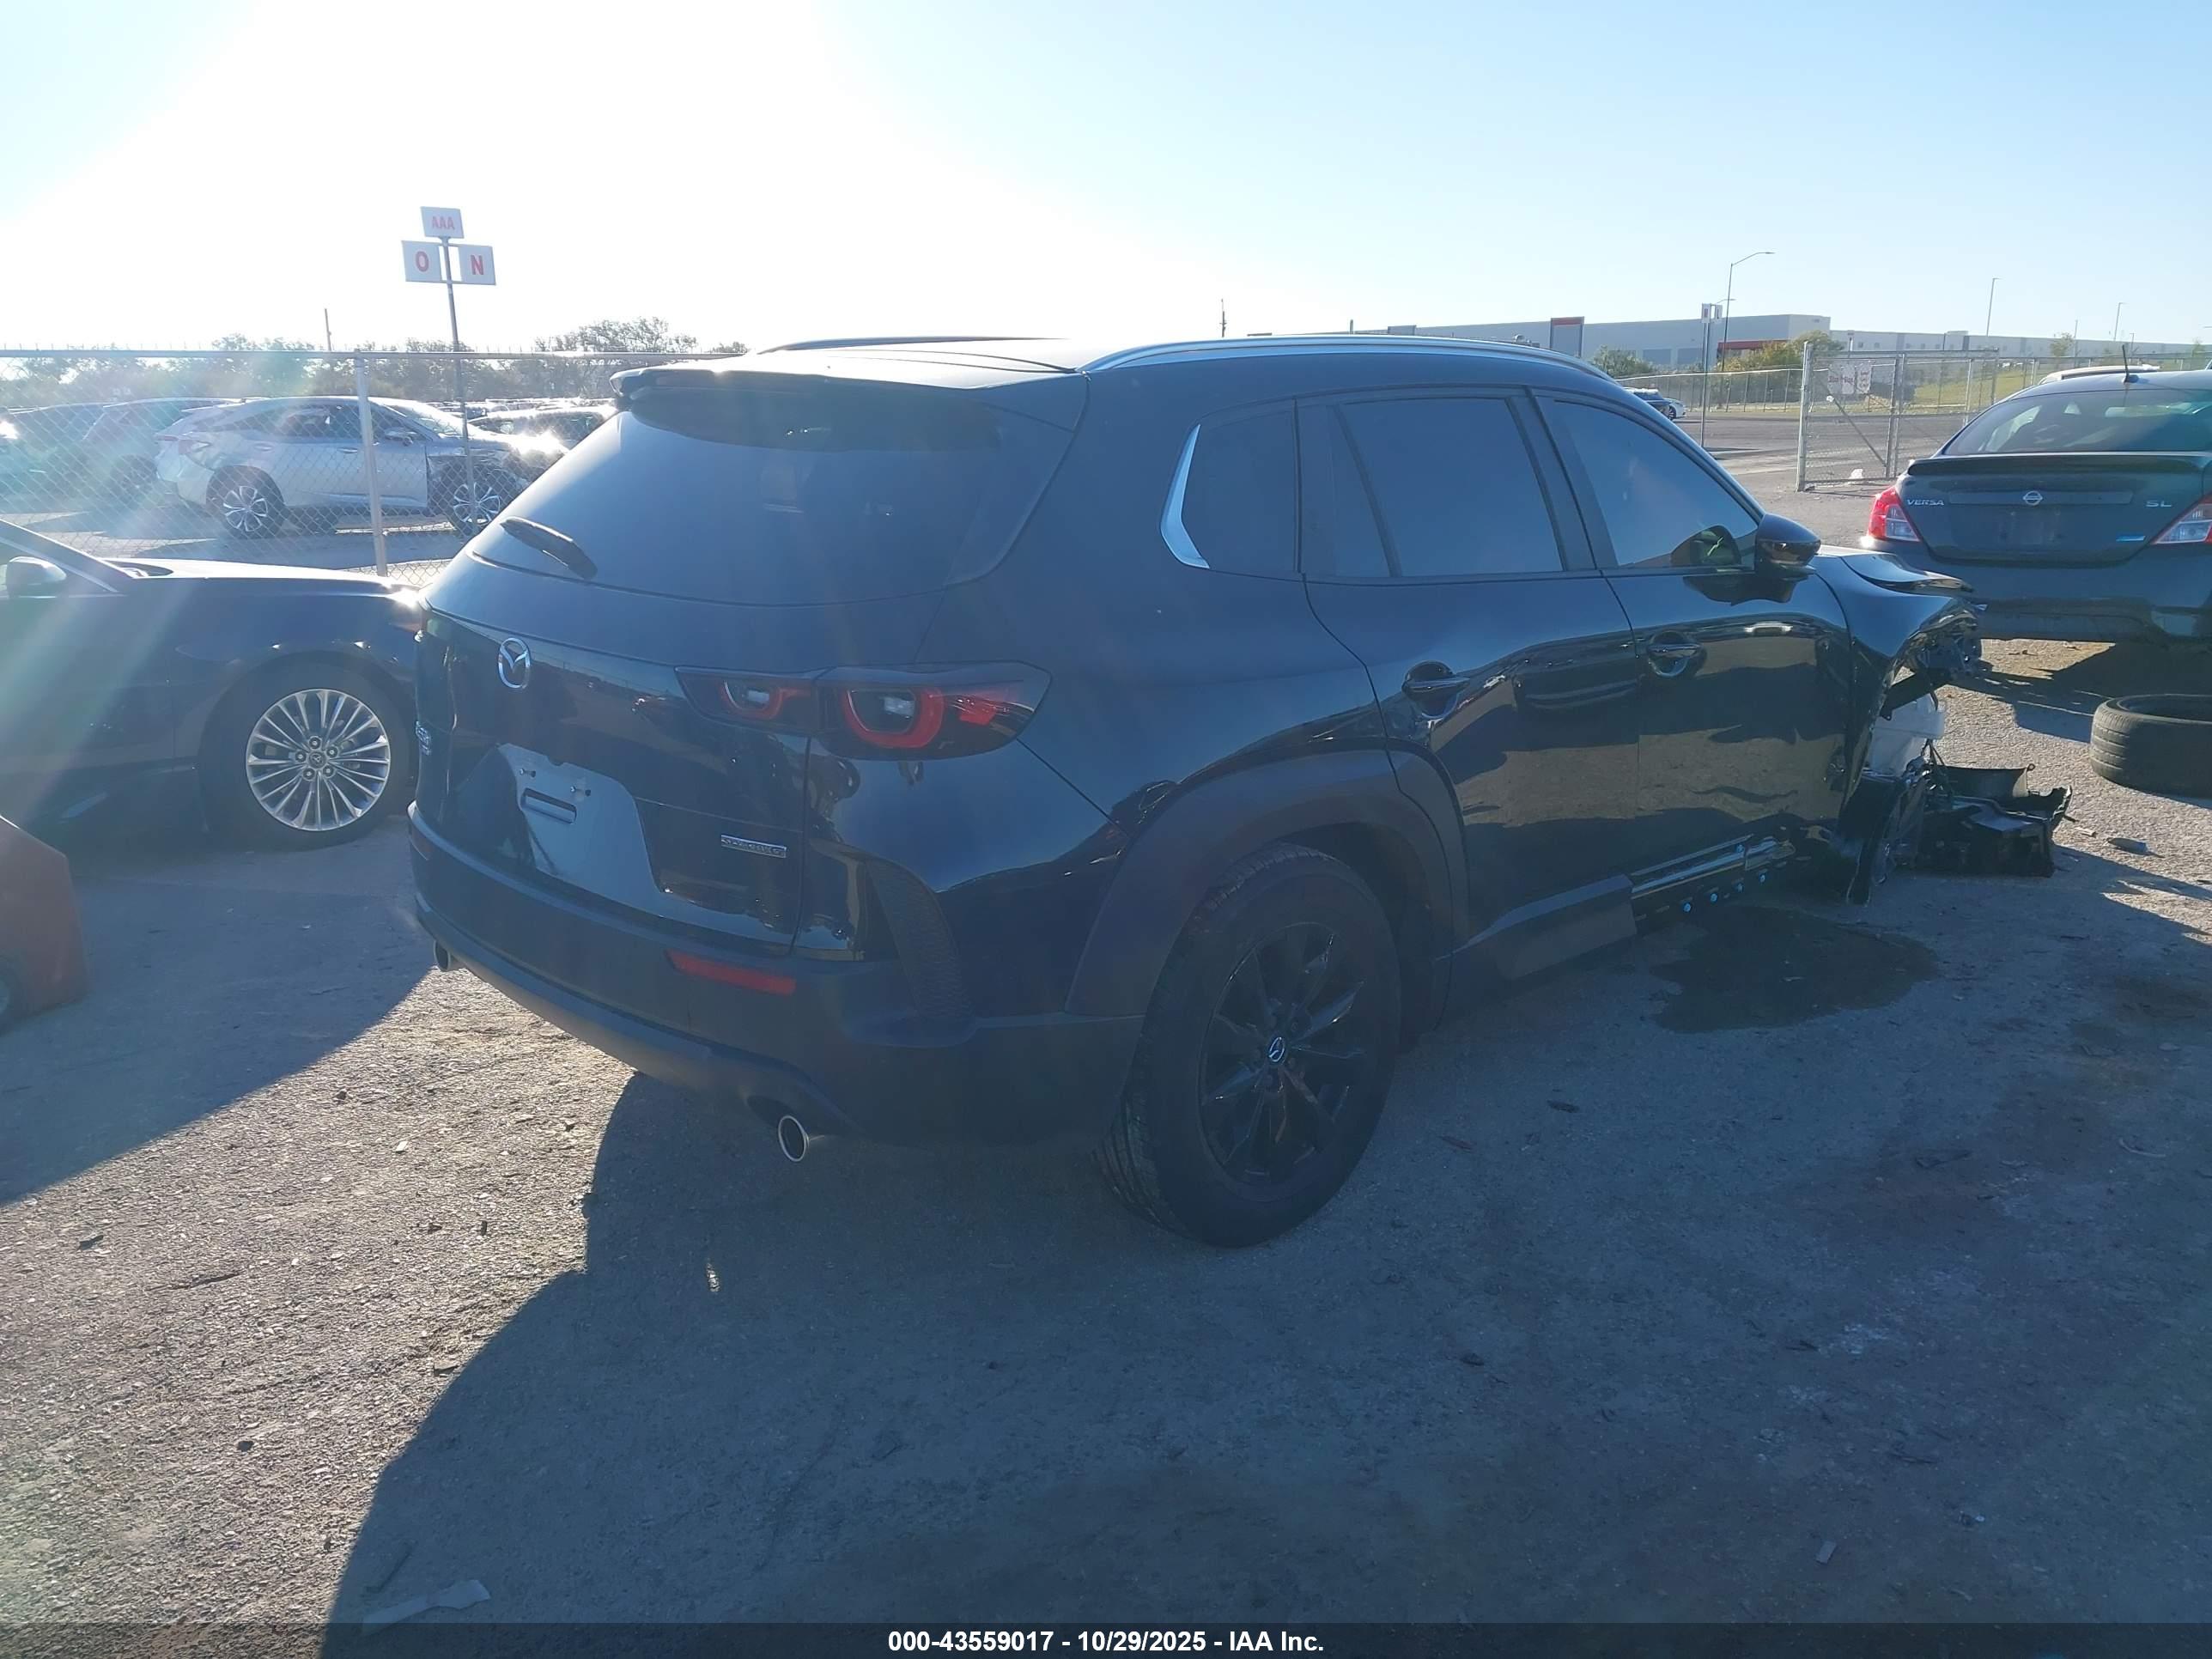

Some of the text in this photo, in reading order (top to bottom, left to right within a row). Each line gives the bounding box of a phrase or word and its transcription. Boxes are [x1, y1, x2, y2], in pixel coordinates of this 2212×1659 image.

[416, 251, 429, 272] O
[471, 255, 483, 275] N
[2145, 499, 2172, 507] SL
